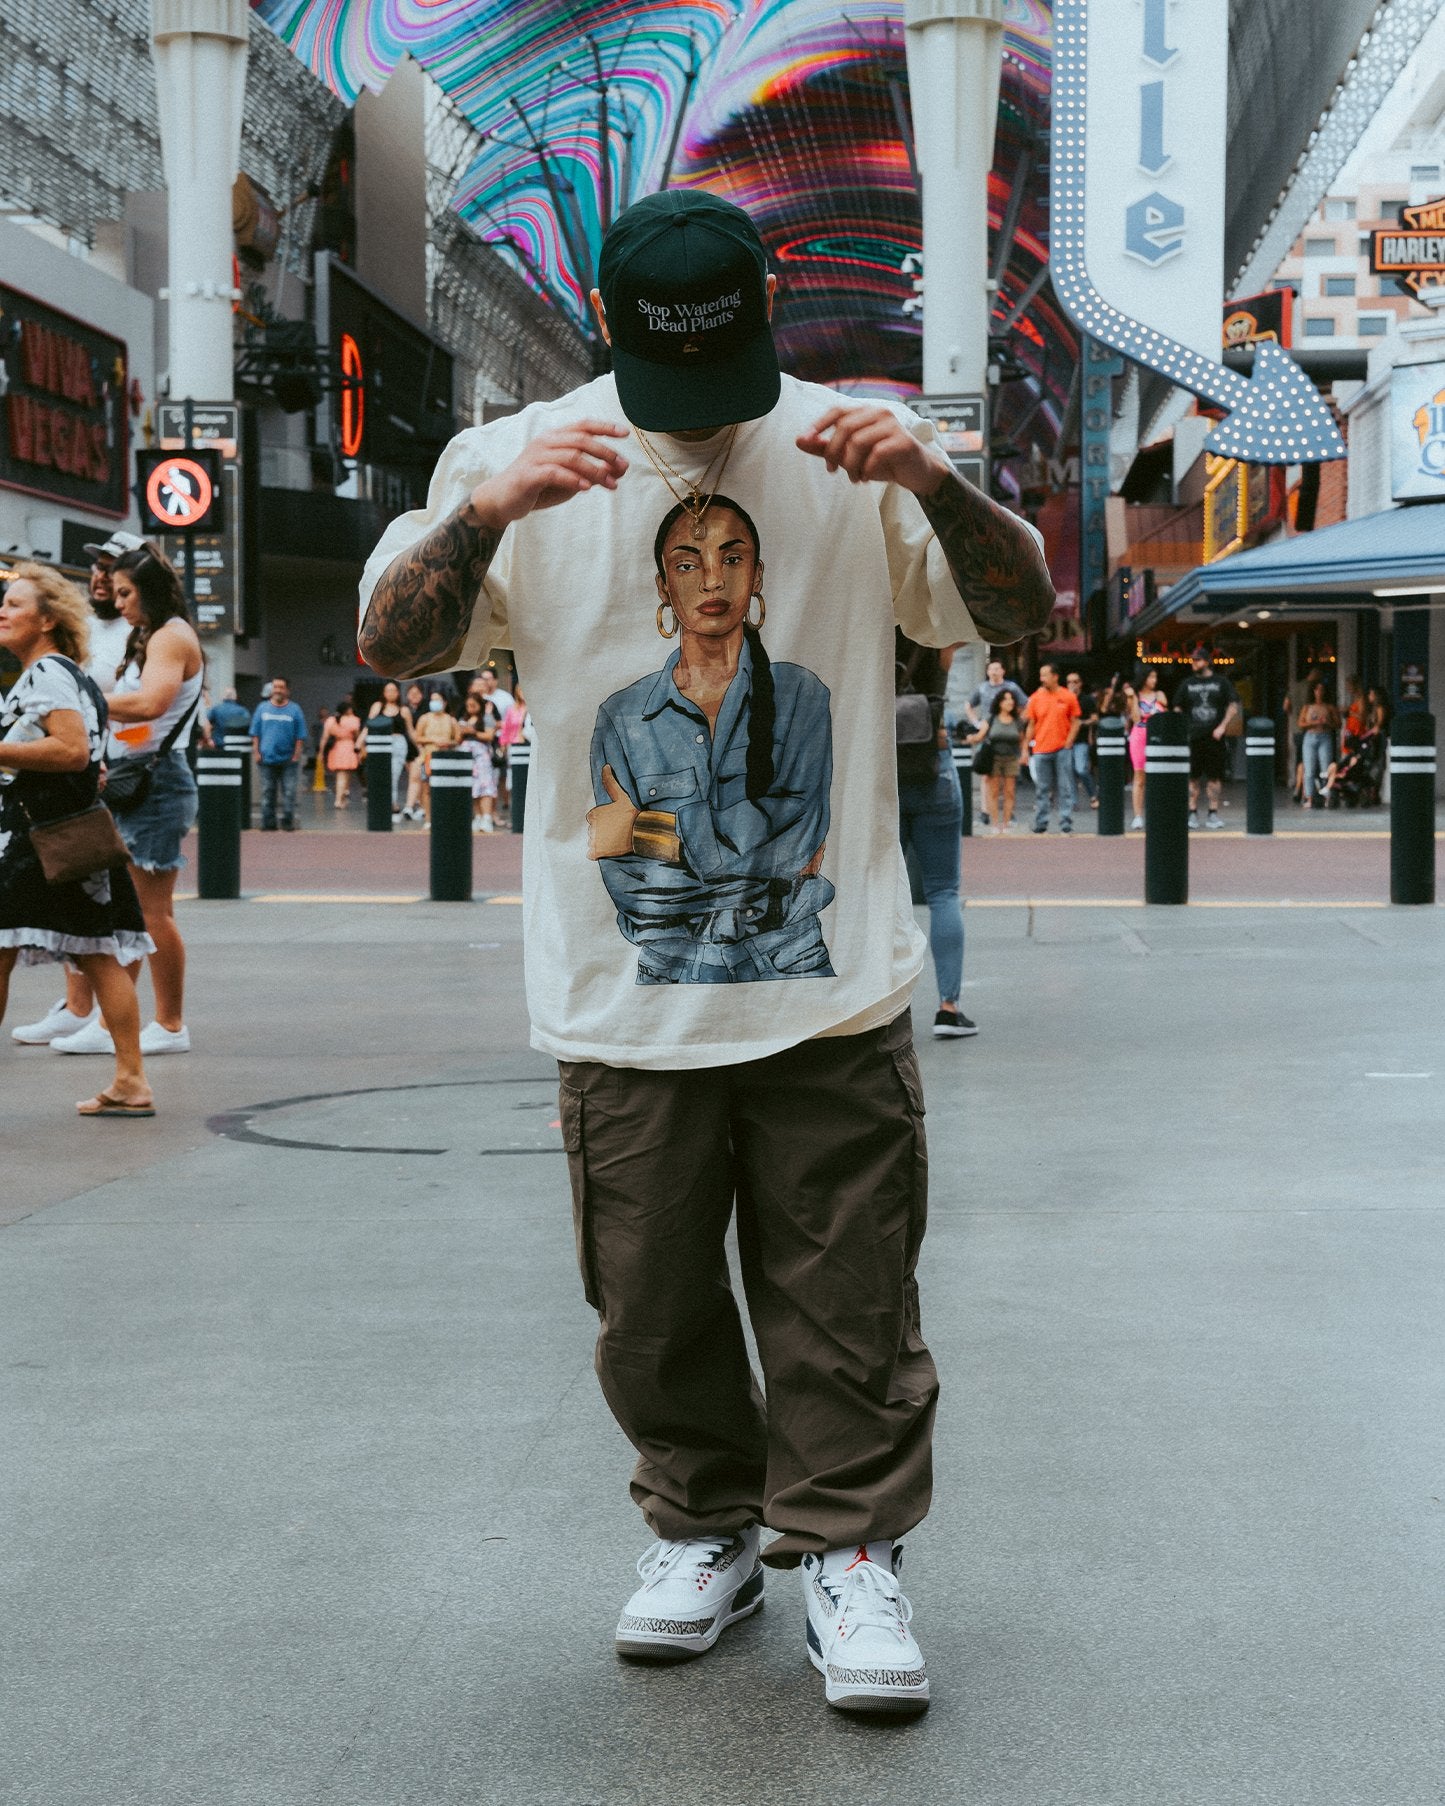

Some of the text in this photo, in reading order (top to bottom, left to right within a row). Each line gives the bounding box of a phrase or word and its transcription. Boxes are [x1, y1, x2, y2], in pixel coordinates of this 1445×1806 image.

[638, 288, 741, 320] Stop Watering
[649, 310, 734, 332] Dead Plants
[6, 394, 109, 482] VEGAS
